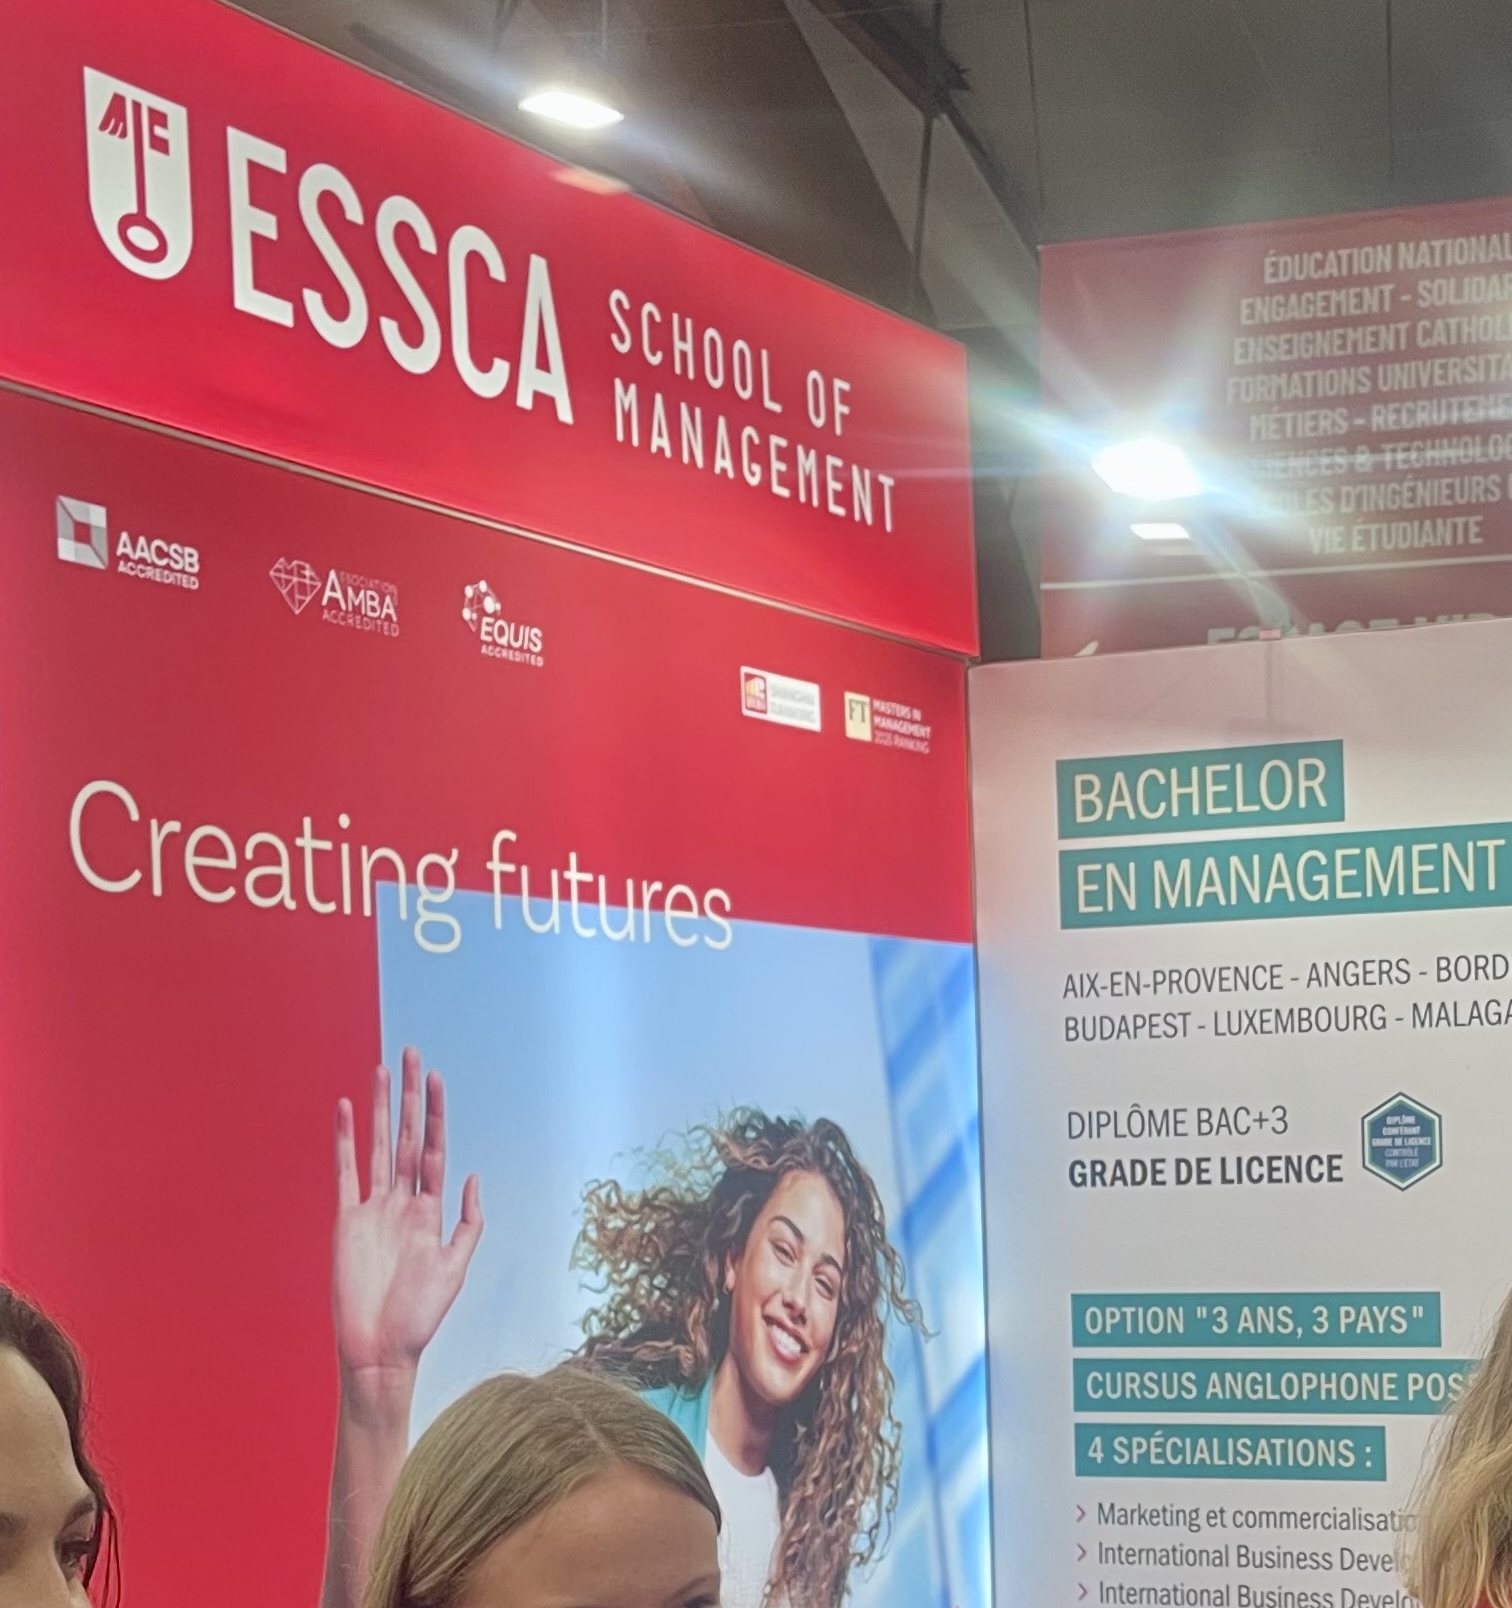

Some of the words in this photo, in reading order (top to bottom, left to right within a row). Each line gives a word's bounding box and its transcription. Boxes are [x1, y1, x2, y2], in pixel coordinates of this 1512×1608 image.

[226, 126, 574, 425] ESSCA
[1264, 245, 1392, 284] ÉDUCATION
[1240, 283, 1396, 325] ENGAGEMENT
[610, 289, 781, 415] SCHOOL
[807, 370, 851, 437] OF
[1232, 322, 1409, 365] ENSEIGNEMENT
[1226, 365, 1372, 404] FORMATIONS
[1250, 406, 1348, 442] MÉTIERS
[614, 377, 896, 533] MANAGEMENT
[1340, 471, 1501, 513] D'INGÉNIEURS
[116, 531, 200, 573] AACSB
[1309, 525, 1345, 555] VIE
[1352, 516, 1484, 551] ÉTUDIANTE
[118, 560, 199, 590] ACCREDITED
[322, 609, 399, 637] ACCREDITED
[480, 617, 542, 653] EQUIS
[481, 644, 544, 667] ACCREDITED
[848, 698, 867, 723] FT
[1073, 756, 1330, 824] BACHELOR
[69, 780, 462, 954] Creating
[486, 830, 732, 950] futures
[1077, 862, 1137, 914] EN
[1151, 837, 1507, 910] MANAGEMENT
[1063, 963, 1285, 1000] AIX-EN-PROVENCE
[1306, 956, 1413, 990] ANGERS
[1064, 1010, 1192, 1044] BUDAPEST
[1213, 1002, 1388, 1039] LUXEMBOURG
[1067, 1103, 1189, 1141] DIPLÔME
[1197, 1104, 1290, 1138] BAC+3
[1068, 1158, 1167, 1188] GRADE
[1175, 1157, 1212, 1187] DE
[1219, 1154, 1345, 1186] LICENCE
[1084, 1306, 1185, 1335] OPTION
[1195, 1306, 1229, 1334] "3
[1236, 1305, 1303, 1339] ANS,
[1311, 1306, 1330, 1334] 3
[1339, 1305, 1425, 1335] PAYS"
[1086, 1371, 1198, 1400] CURSUS
[1205, 1372, 1399, 1401] ANGLOPHONE
[1407, 1372, 1466, 1402] POS
[1087, 1436, 1104, 1462] 4
[1112, 1429, 1356, 1468] SPÉCIALISATIONS
[1365, 1445, 1372, 1468] :
[1097, 1502, 1201, 1533] Marketing
[1205, 1509, 1228, 1529] et
[1232, 1506, 1424, 1533] commercialisatio
[1098, 1541, 1230, 1568] International
[1236, 1545, 1333, 1571] Business
[1099, 1581, 1231, 1608] International
